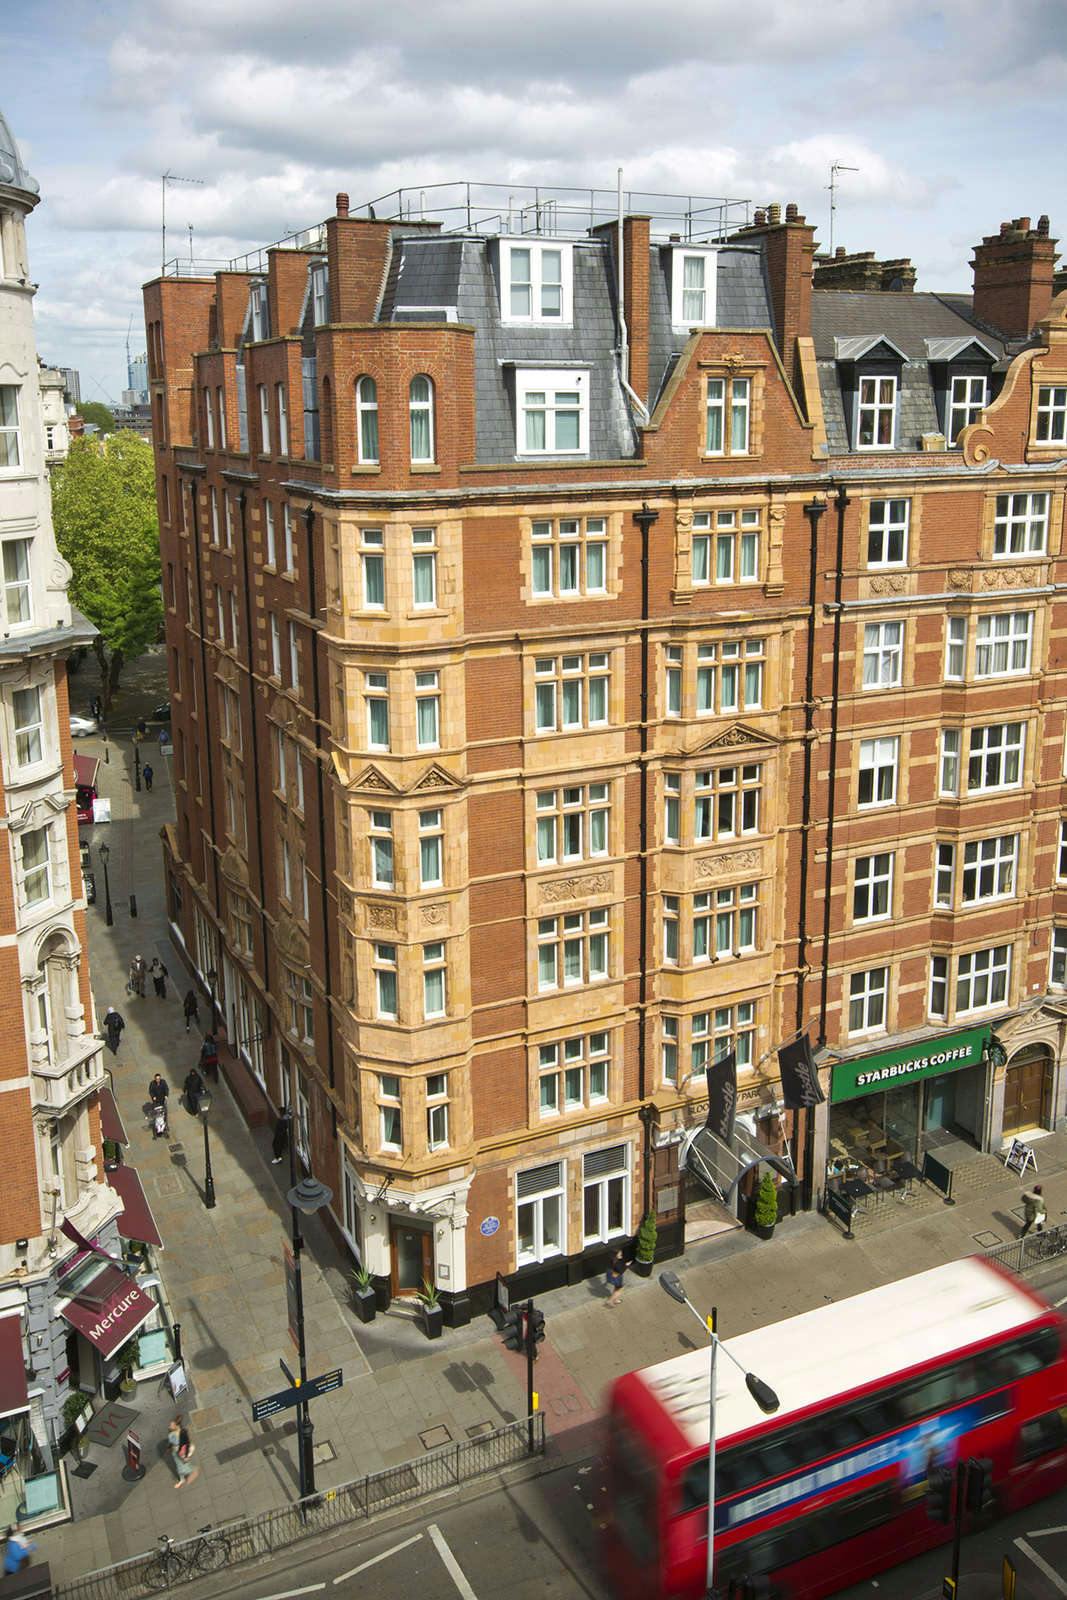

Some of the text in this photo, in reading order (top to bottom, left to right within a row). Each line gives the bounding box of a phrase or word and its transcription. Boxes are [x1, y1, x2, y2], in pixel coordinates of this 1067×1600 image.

[857, 1046, 972, 1086] STARBUCKS COFFEE
[88, 1288, 141, 1340] Mercure
